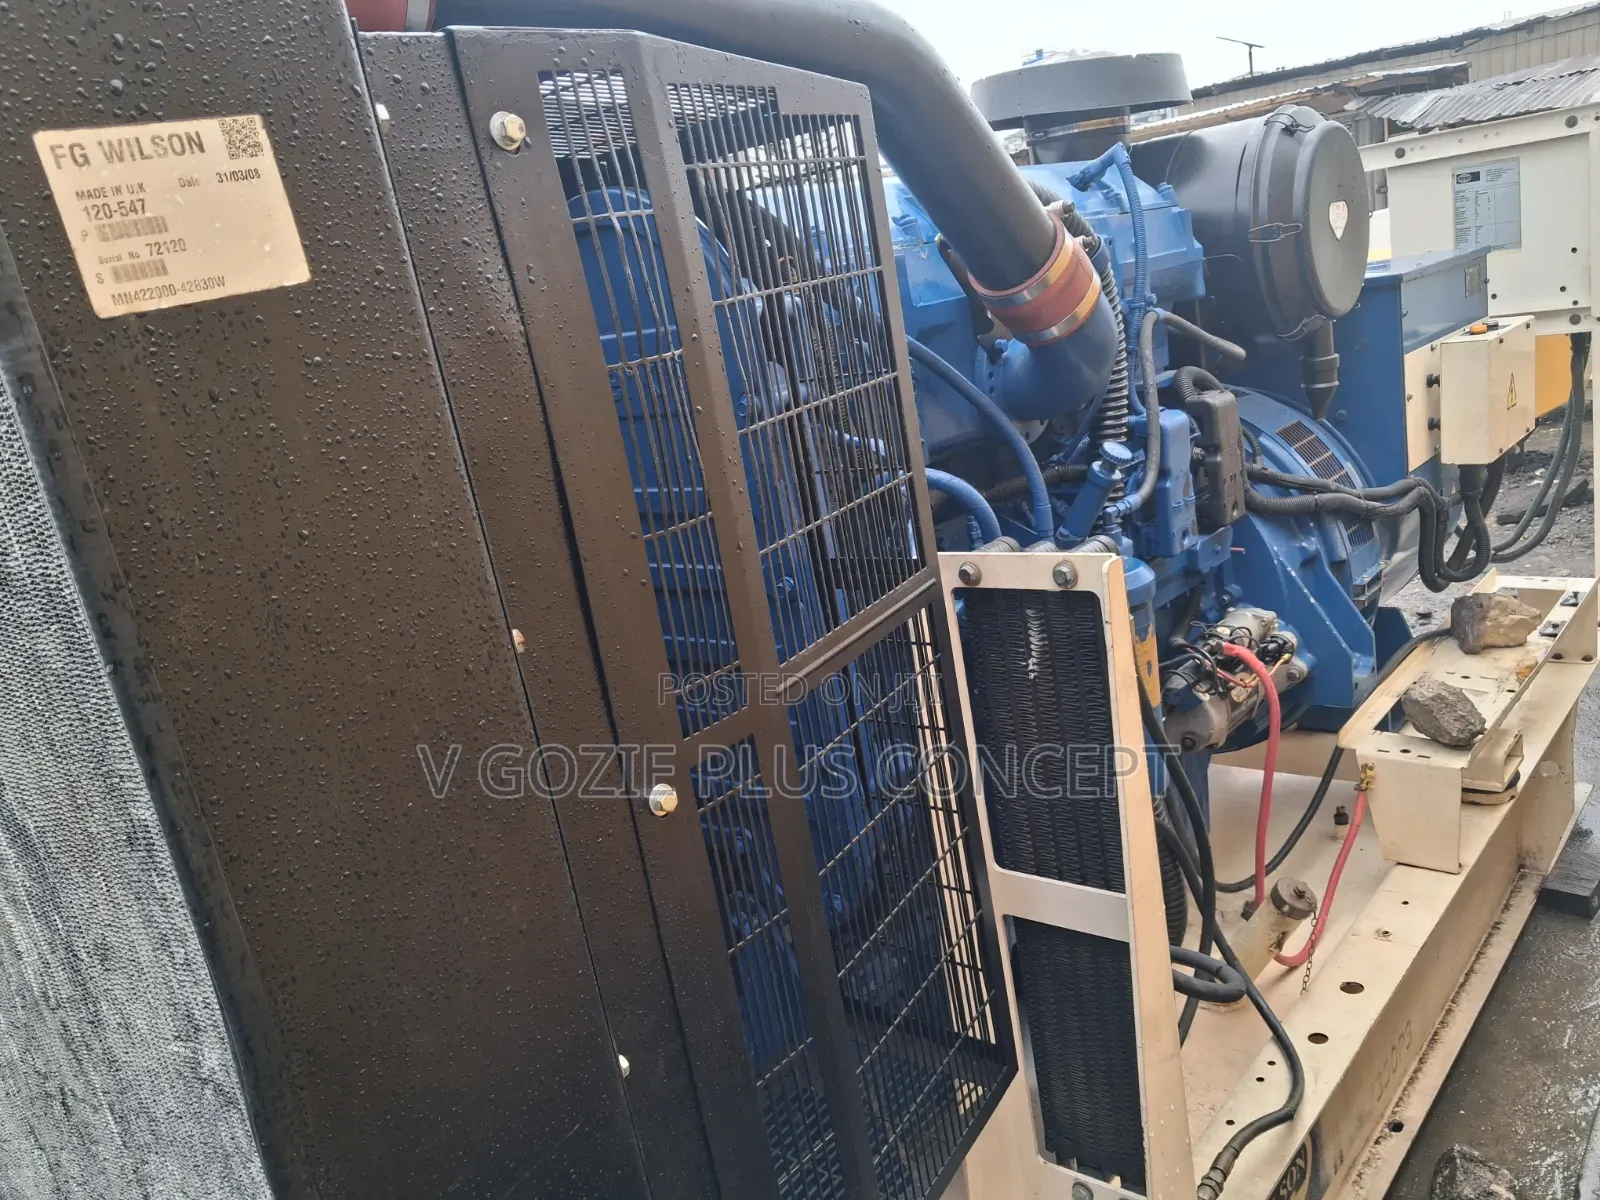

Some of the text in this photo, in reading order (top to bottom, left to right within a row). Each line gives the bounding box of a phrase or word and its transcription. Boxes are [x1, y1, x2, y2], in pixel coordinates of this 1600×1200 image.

[49, 130, 206, 169] FG WILSON
[216, 168, 261, 183] 31/03/08
[75, 182, 147, 201] MADE IN U.K
[82, 198, 146, 222] 120-547
[97, 254, 123, 264] Serial
[145, 238, 187, 256] 72120
[95, 272, 105, 285] S
